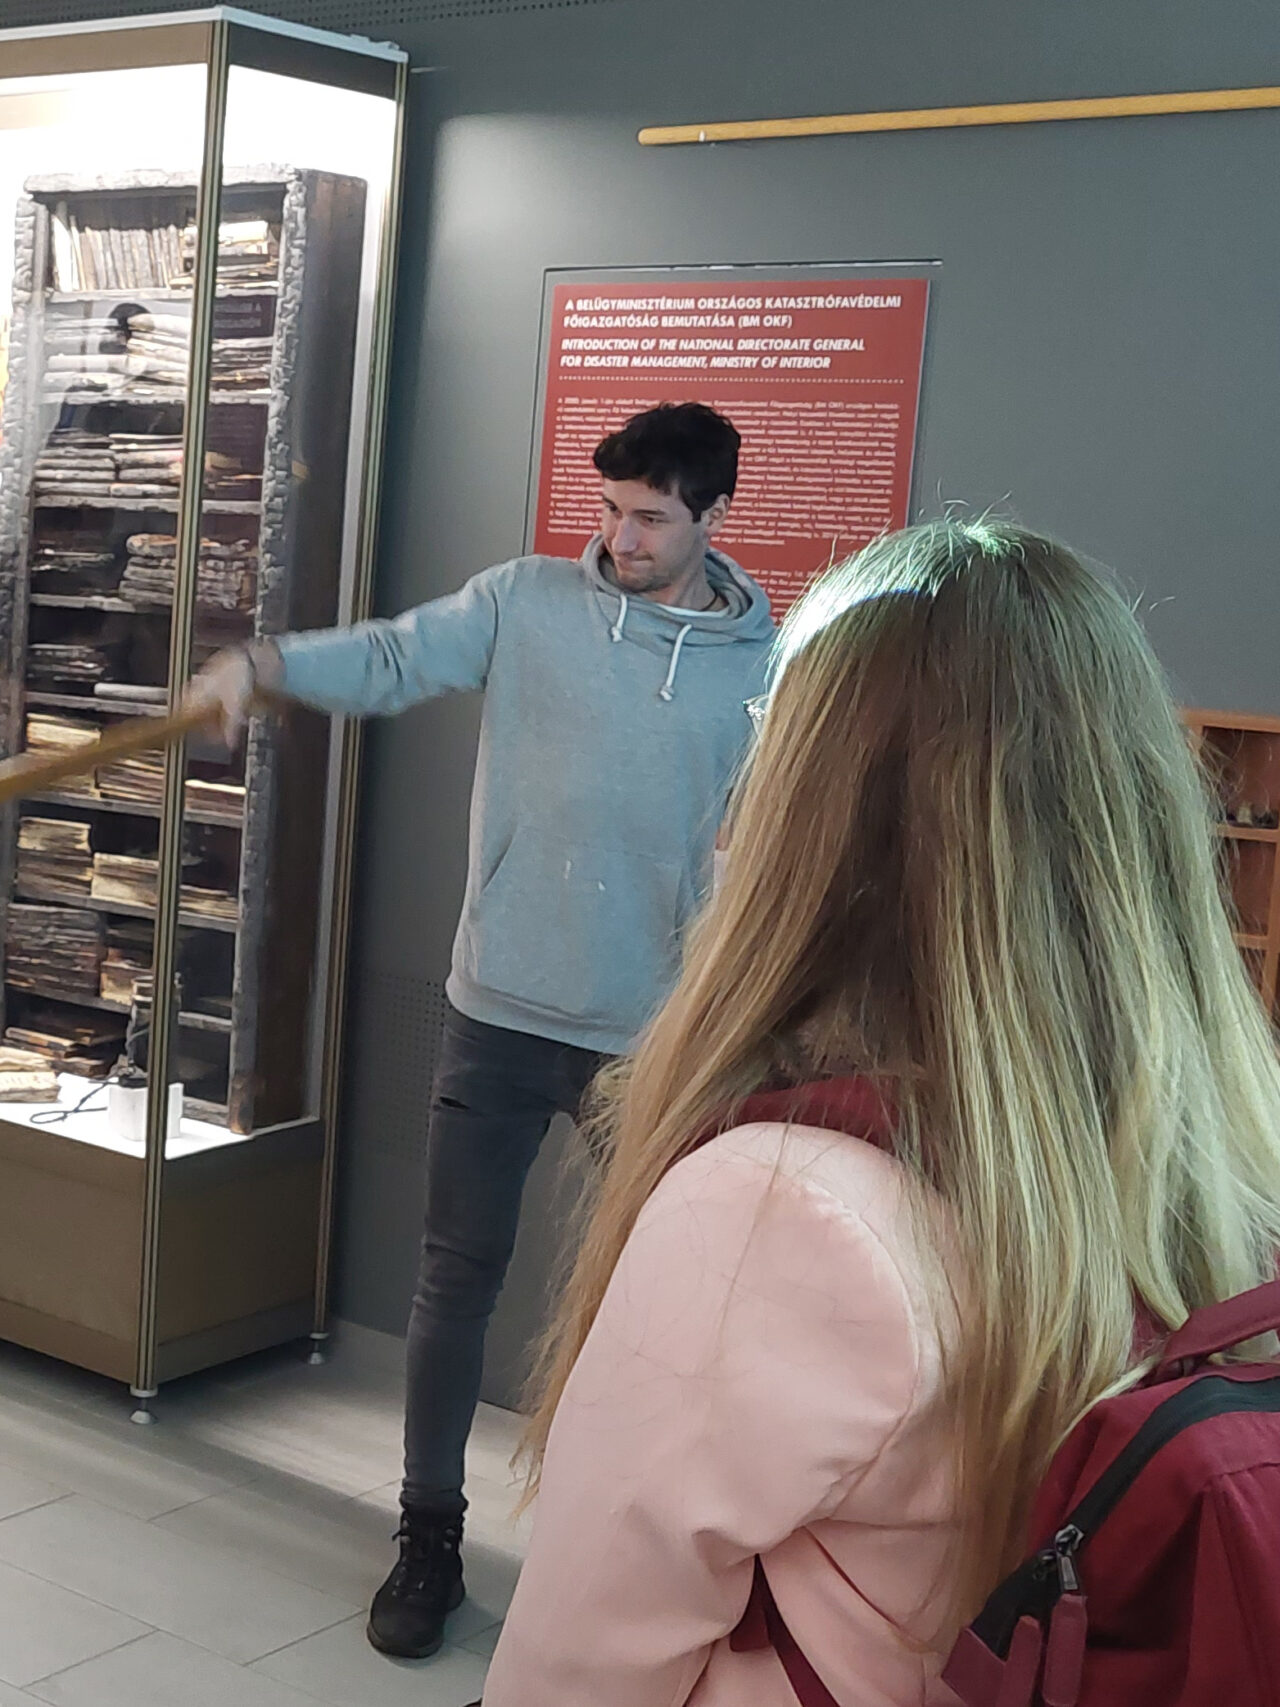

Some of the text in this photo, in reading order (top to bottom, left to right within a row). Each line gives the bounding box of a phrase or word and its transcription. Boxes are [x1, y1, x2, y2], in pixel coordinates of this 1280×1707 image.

[565, 299, 574, 311] A
[697, 295, 762, 310] ORSZÁGOS
[765, 293, 902, 309] KATASZTRÓFAVÉDELMI
[661, 313, 735, 328] BEMUTATÁSA
[738, 315, 760, 328] (BM
[763, 315, 793, 328] OKF)
[561, 338, 865, 351] INTRODUCTION OF THE NATIONAL DIRECTORATE GENERAL
[560, 355, 831, 369] FOR DISASTER MANAGEMENT, MINISTRY OF INTERIOR
